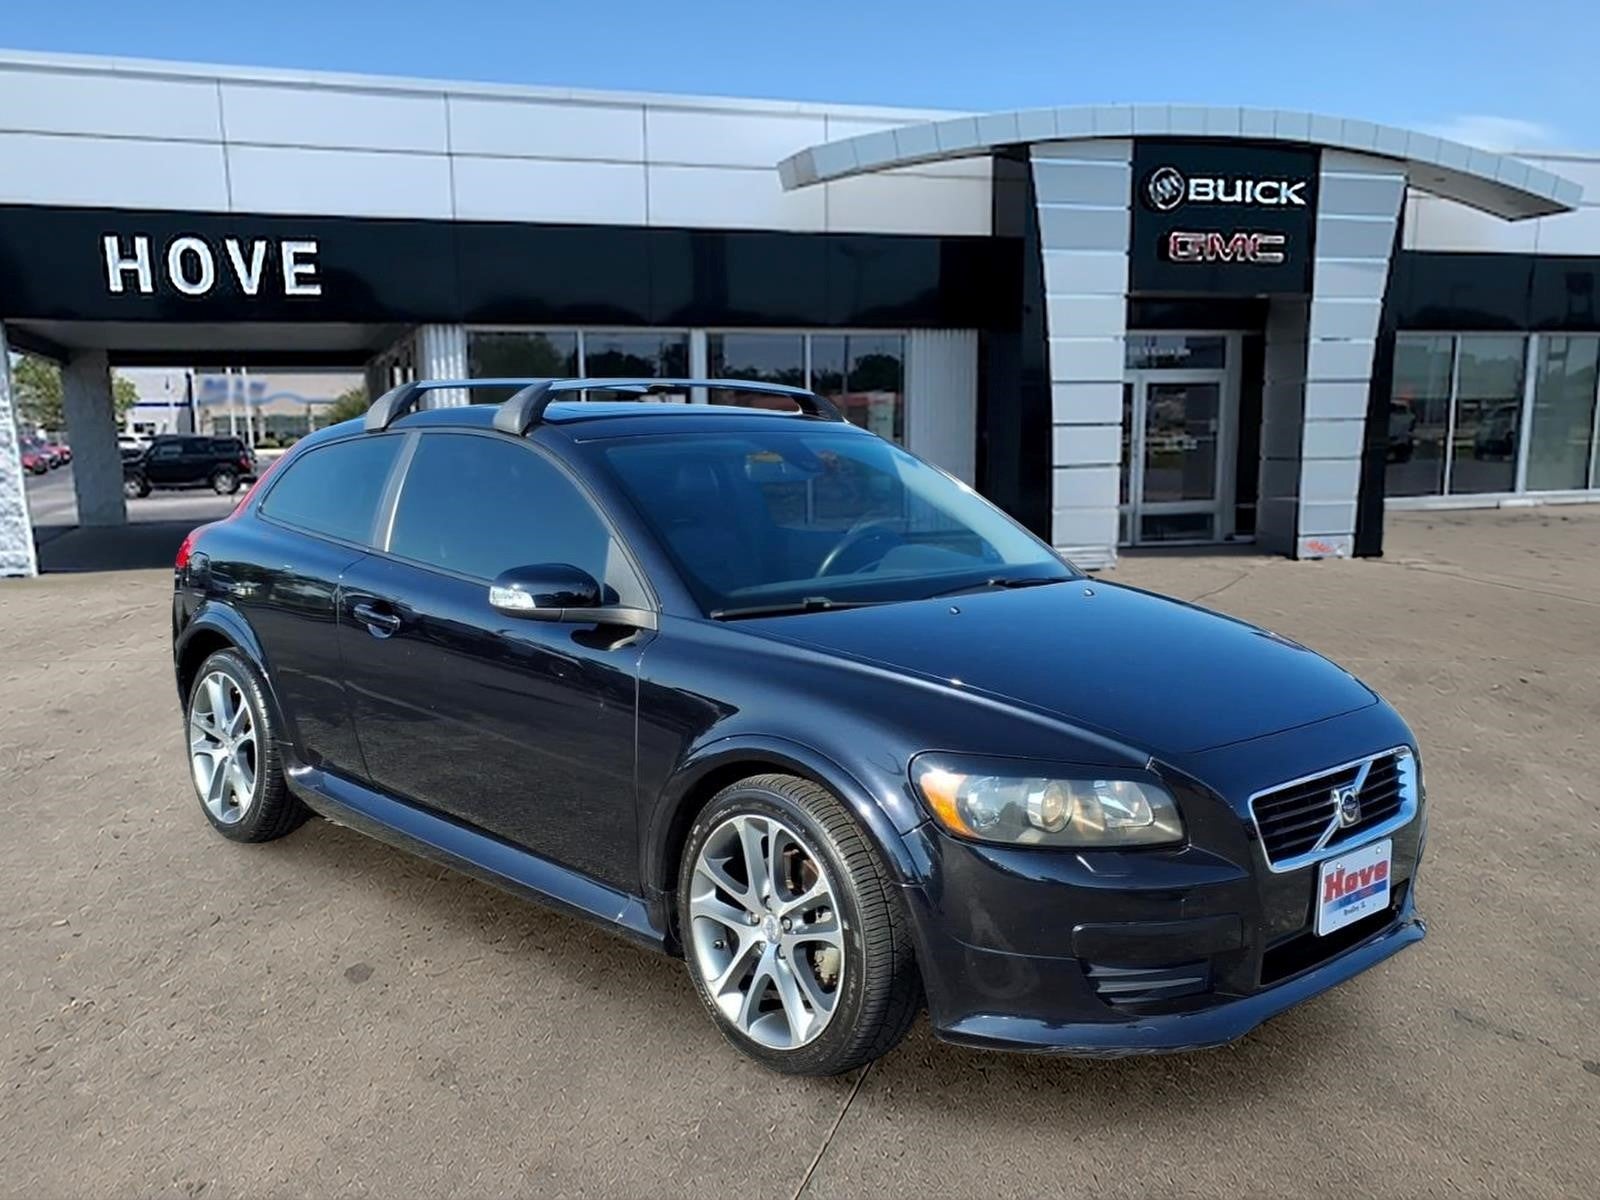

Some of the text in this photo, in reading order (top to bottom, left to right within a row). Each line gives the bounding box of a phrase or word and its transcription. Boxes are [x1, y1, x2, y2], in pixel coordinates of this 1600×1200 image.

[1188, 178, 1307, 205] BUICK
[104, 235, 323, 295] HOVE
[1168, 231, 1286, 263] GMC
[1324, 859, 1388, 904] Hove
